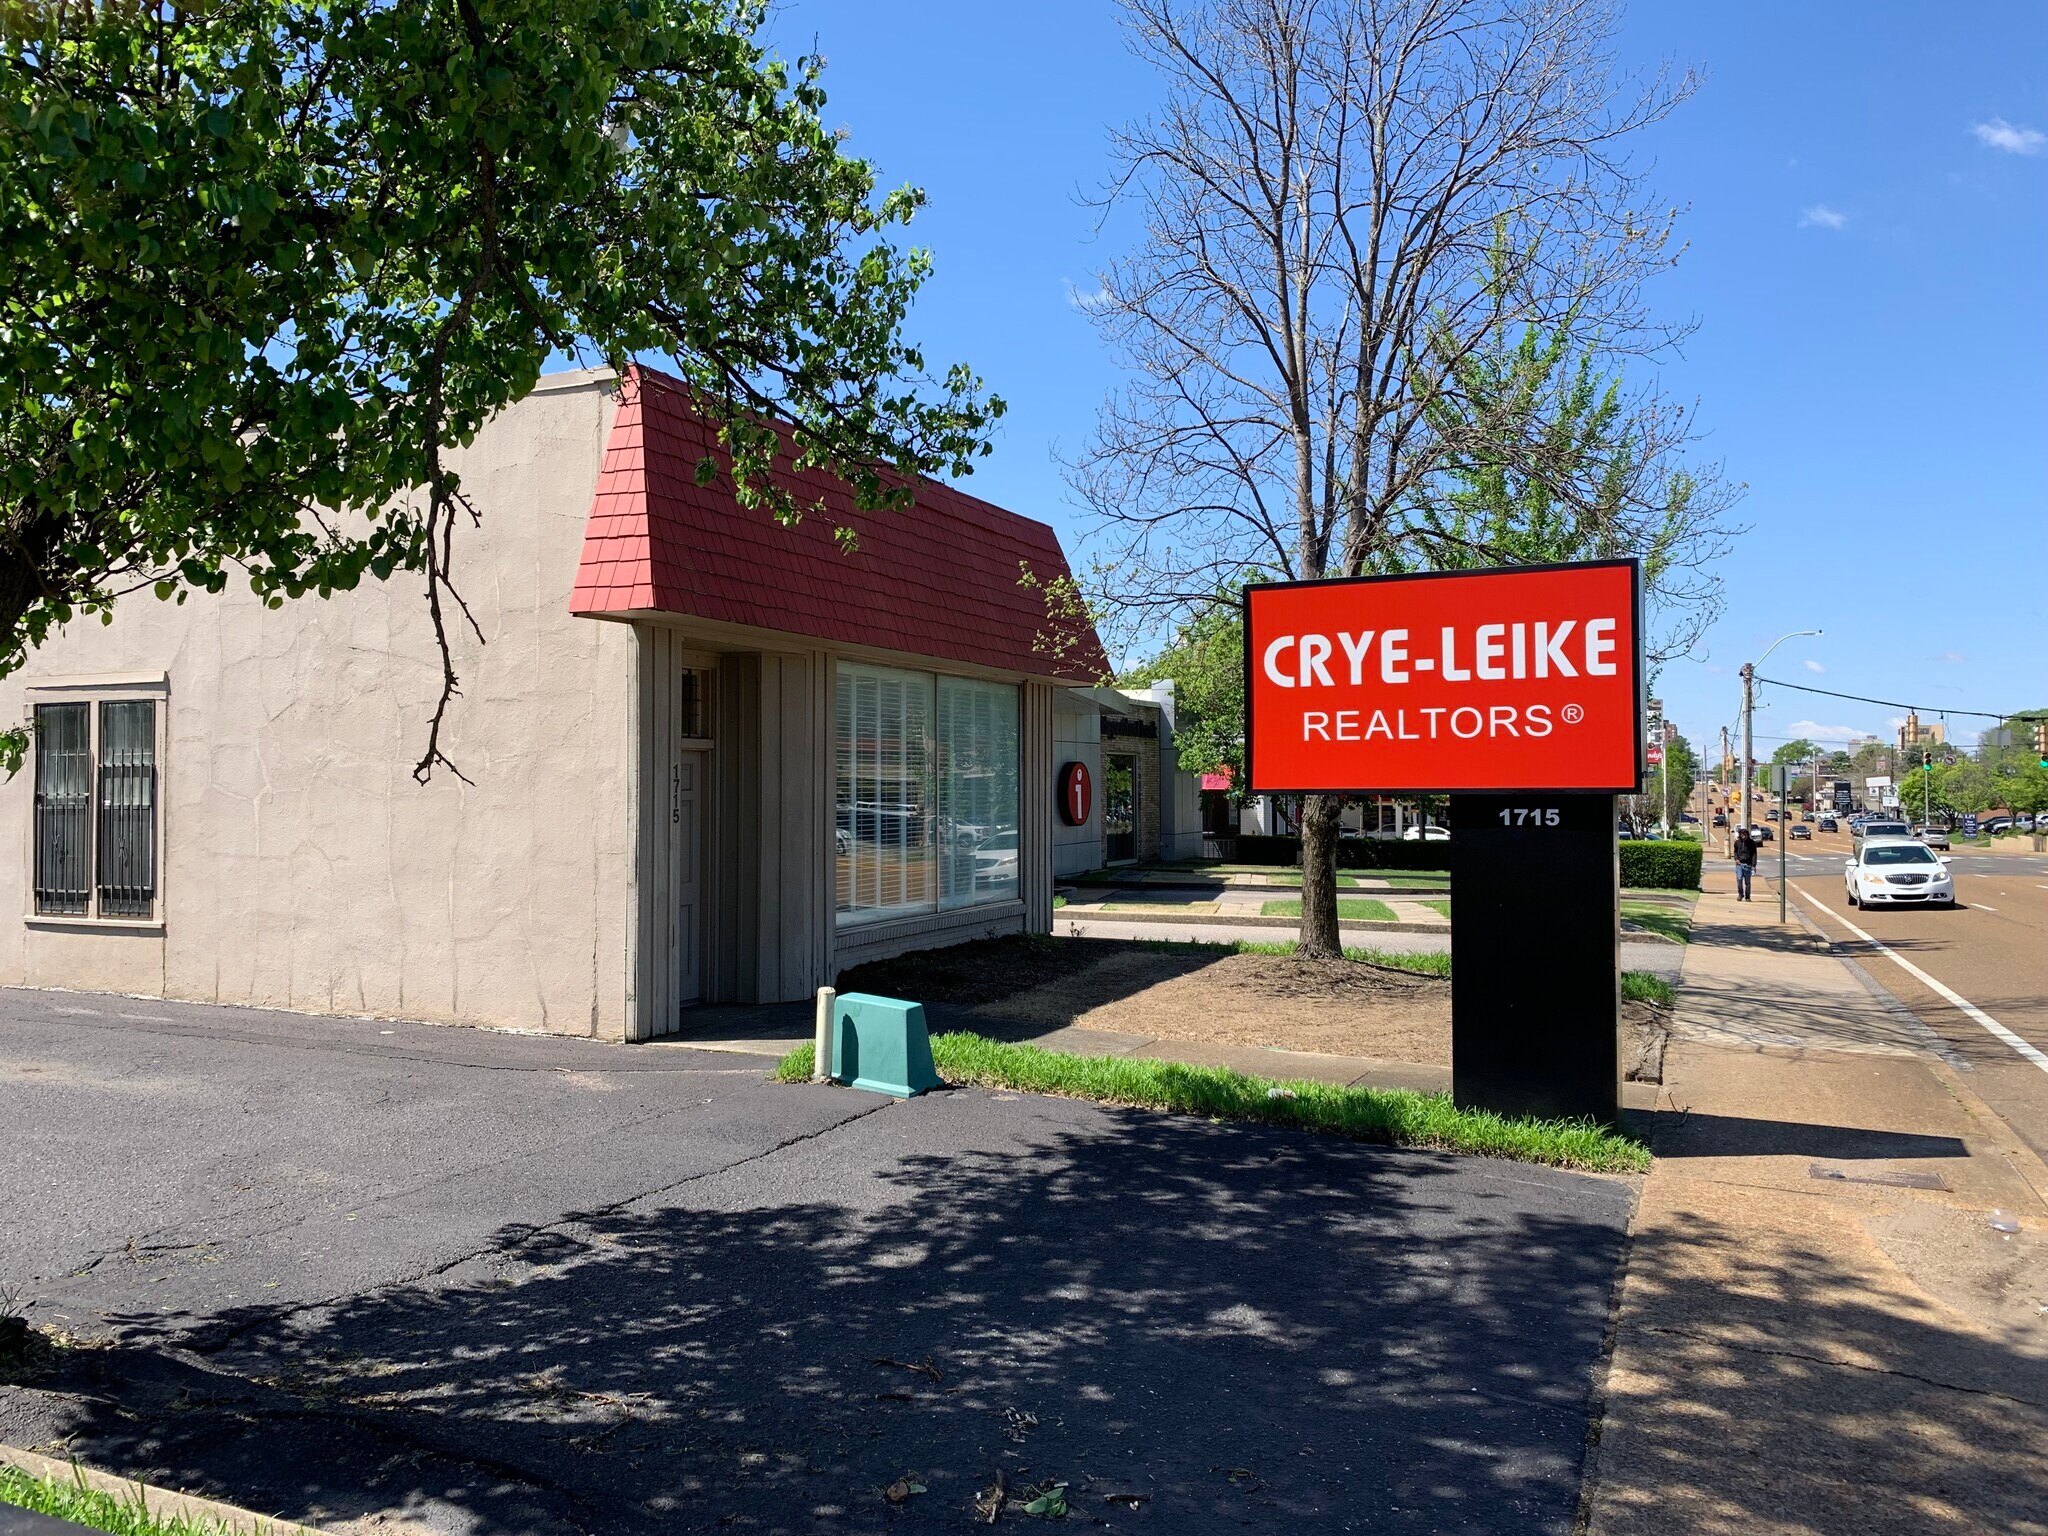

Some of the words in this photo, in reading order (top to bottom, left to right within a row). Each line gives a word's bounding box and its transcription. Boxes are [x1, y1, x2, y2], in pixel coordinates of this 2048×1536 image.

[1263, 617, 1617, 688] CRYE-LEIKE
[672, 763, 680, 824] 1715
[1499, 808, 1561, 827] 1715
